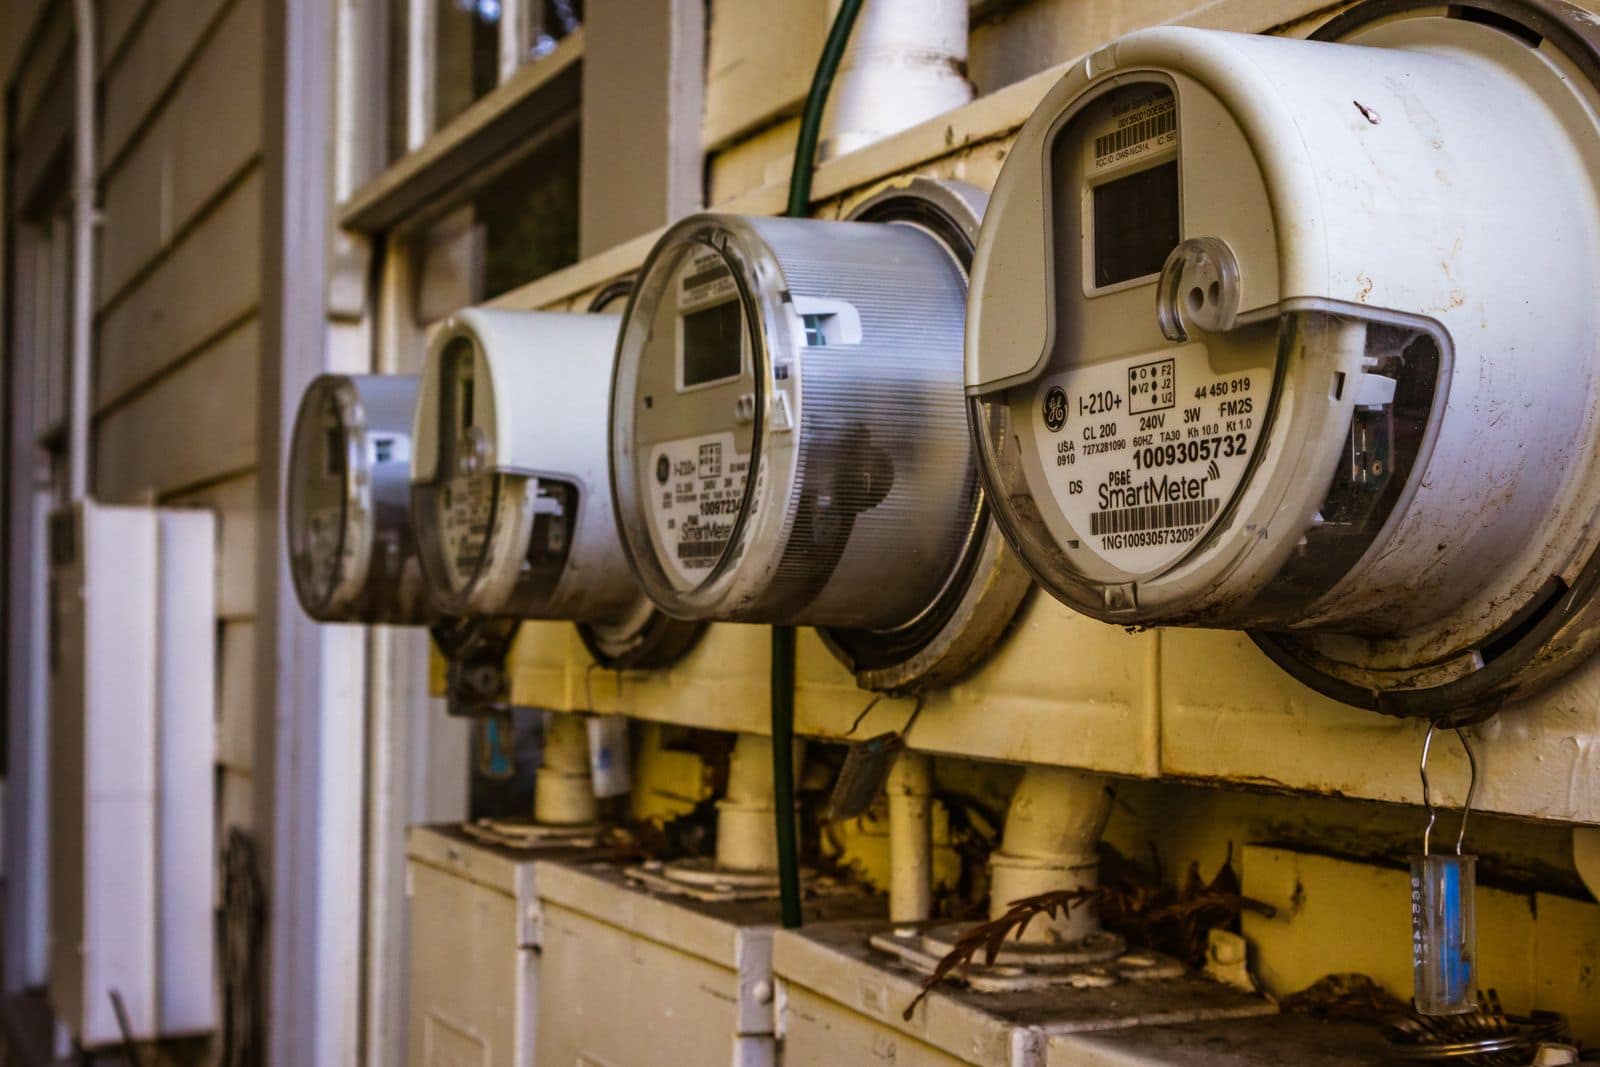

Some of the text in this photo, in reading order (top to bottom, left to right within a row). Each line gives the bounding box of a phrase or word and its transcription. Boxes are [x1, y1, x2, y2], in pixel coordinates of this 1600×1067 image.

[1161, 365, 1172, 376] F2
[1139, 379, 1172, 393] V2 J2
[1194, 378, 1250, 400] 44 450 919
[1079, 390, 1123, 416] I-210+
[1161, 392, 1173, 404] U2
[1083, 398, 1253, 441] CL 200 240V 3W FM2S
[1133, 434, 1153, 447] 60HZ
[1160, 430, 1181, 443] TA30
[1187, 426, 1199, 439] Kh
[1202, 423, 1219, 436] 10.0
[1226, 420, 1237, 433] Kt
[1239, 417, 1252, 430] 1.0
[1057, 440, 1075, 453] USA
[1133, 434, 1247, 470] 1009305732
[1057, 453, 1075, 466] 0910
[1109, 469, 1131, 487] PG&E
[1069, 480, 1083, 495] DS
[1098, 473, 1208, 510] SmartMeter
